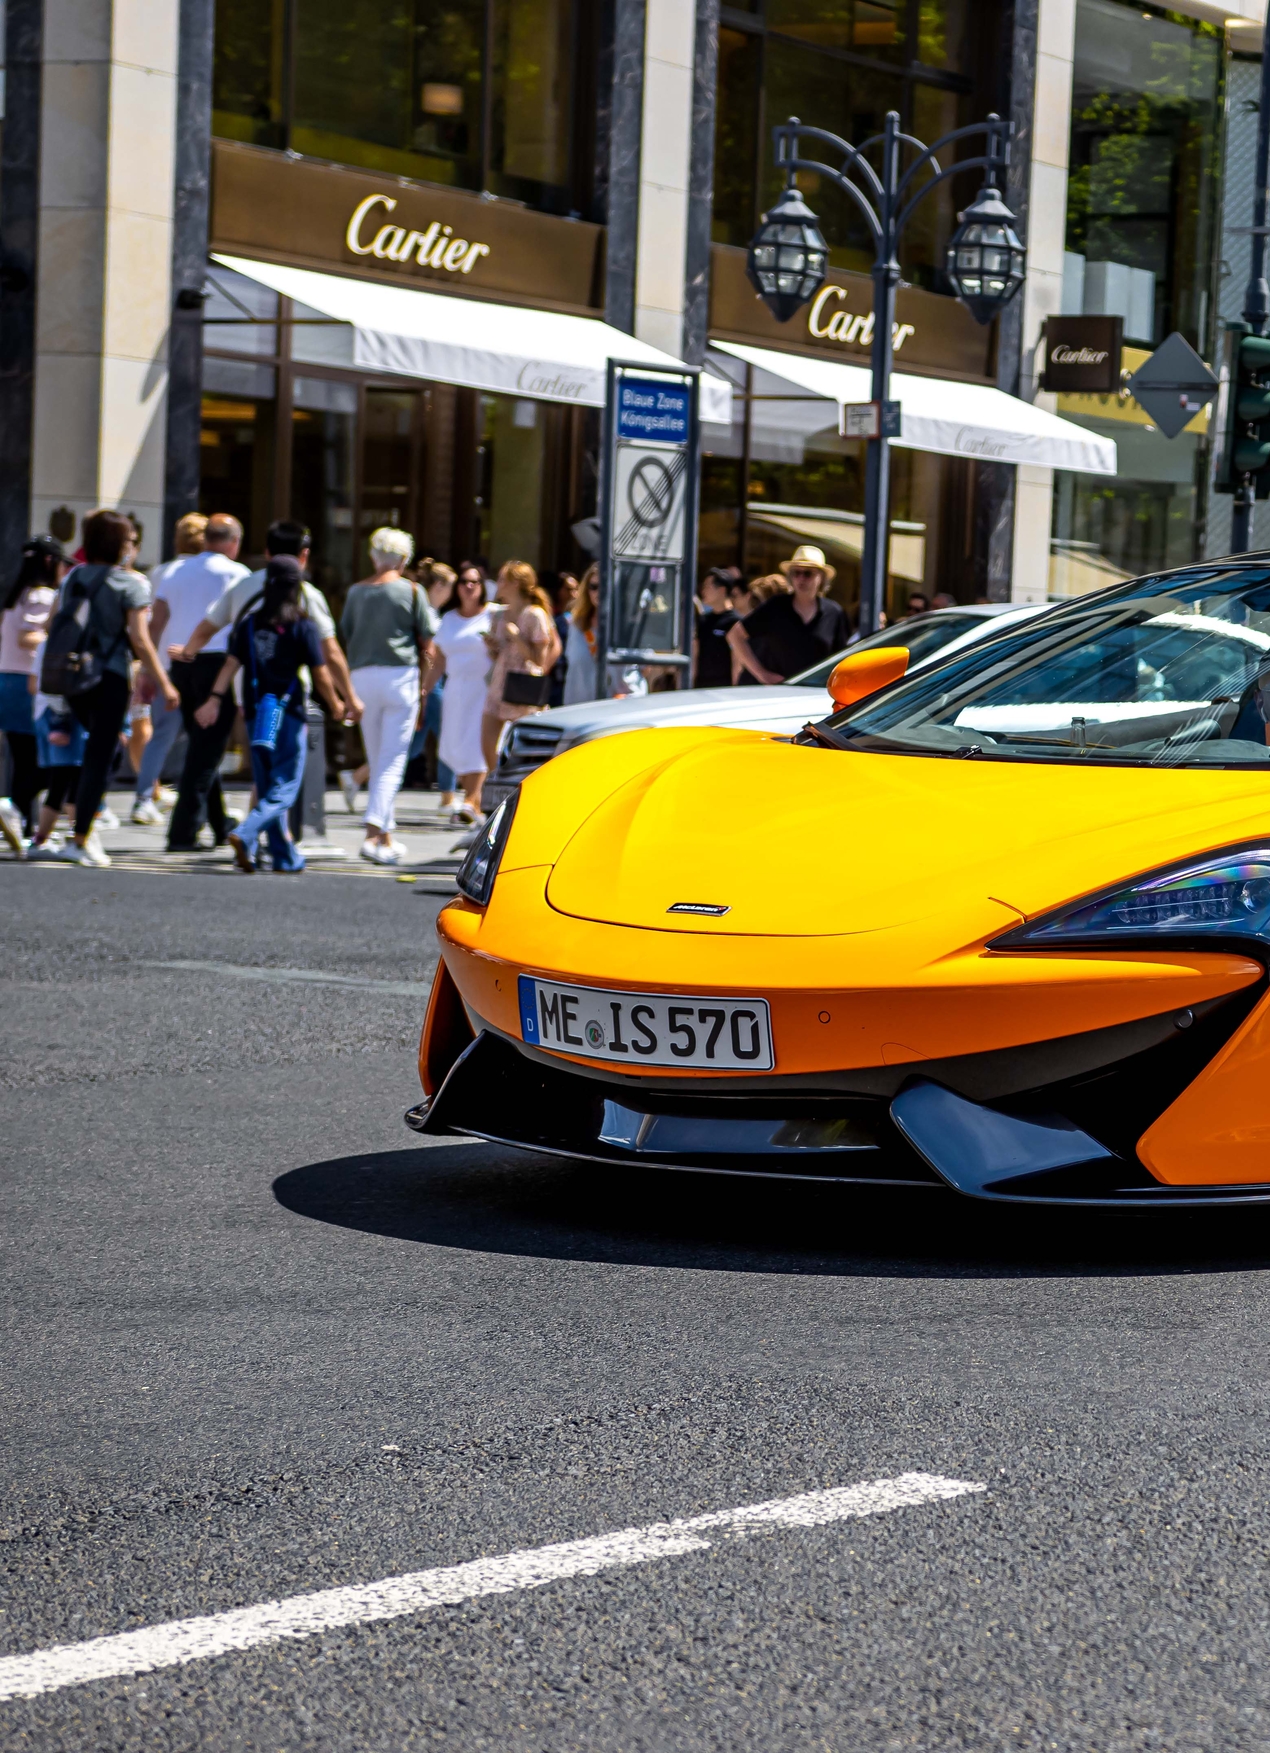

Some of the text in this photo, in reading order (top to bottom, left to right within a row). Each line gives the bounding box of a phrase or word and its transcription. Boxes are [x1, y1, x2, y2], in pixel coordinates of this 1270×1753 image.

[346, 194, 491, 274] Cartier
[809, 285, 915, 351] Cartr
[1050, 344, 1109, 365] Cartier
[516, 361, 588, 399] Cartier
[622, 388, 685, 411] Blaue Zone
[621, 409, 686, 433] Königsallee
[527, 989, 761, 1060] D ME IS 570
